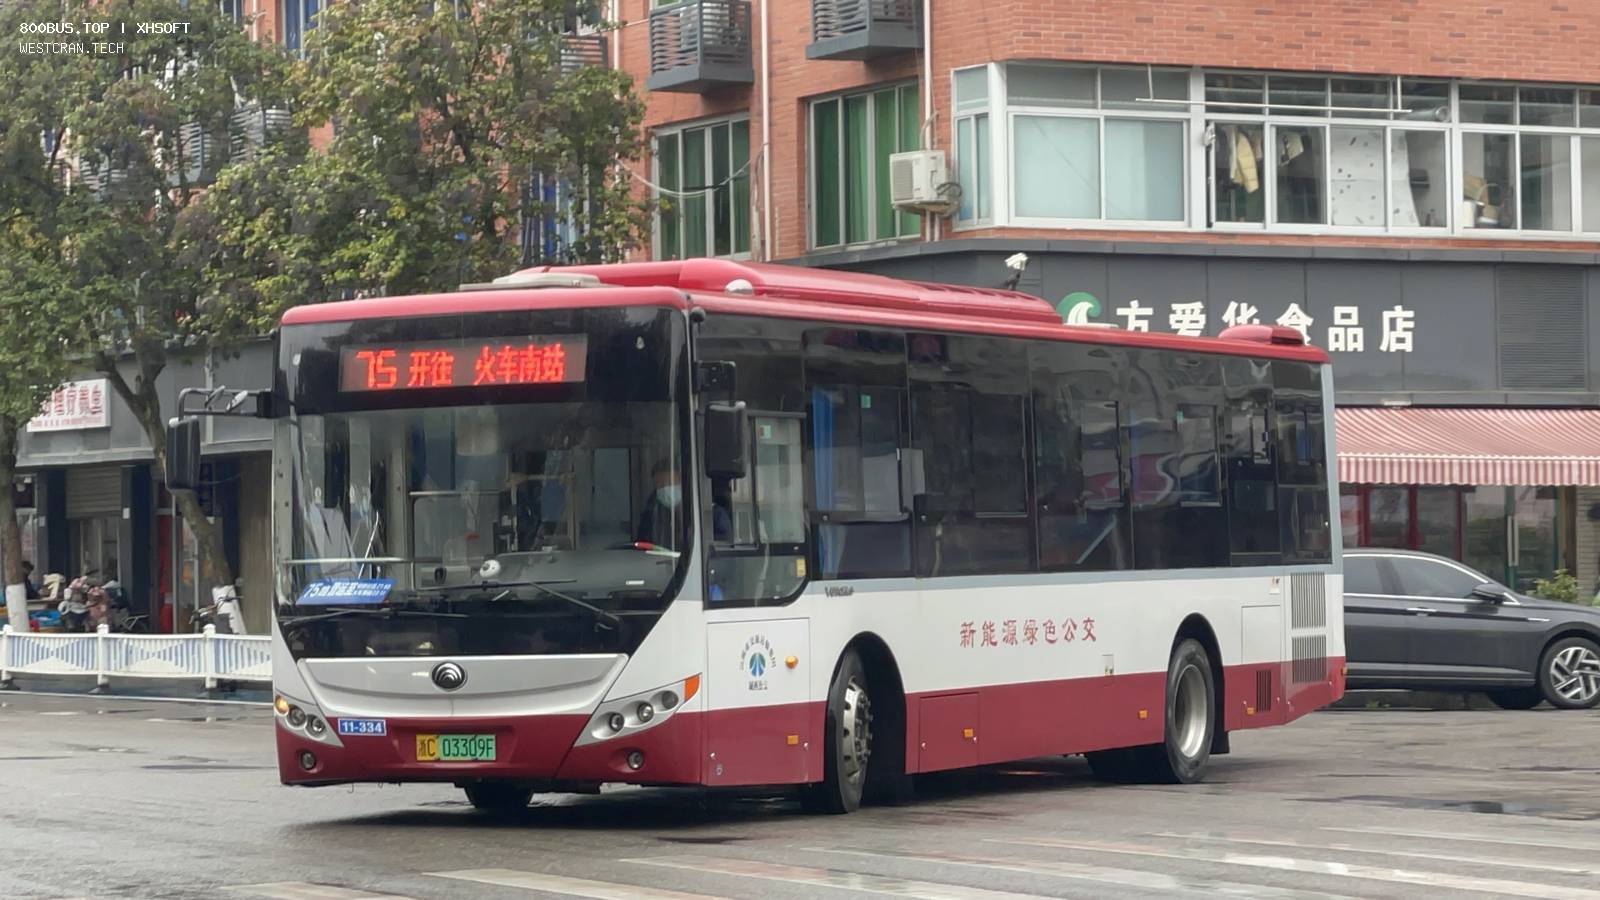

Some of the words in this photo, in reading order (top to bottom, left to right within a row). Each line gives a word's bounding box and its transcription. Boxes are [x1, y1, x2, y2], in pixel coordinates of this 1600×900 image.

[356, 349, 398, 388] 75
[473, 343, 565, 386] 火车南站
[960, 617, 1097, 648] 新能源绿色公交
[342, 721, 382, 733] 11-334
[442, 738, 495, 757] 03309F
